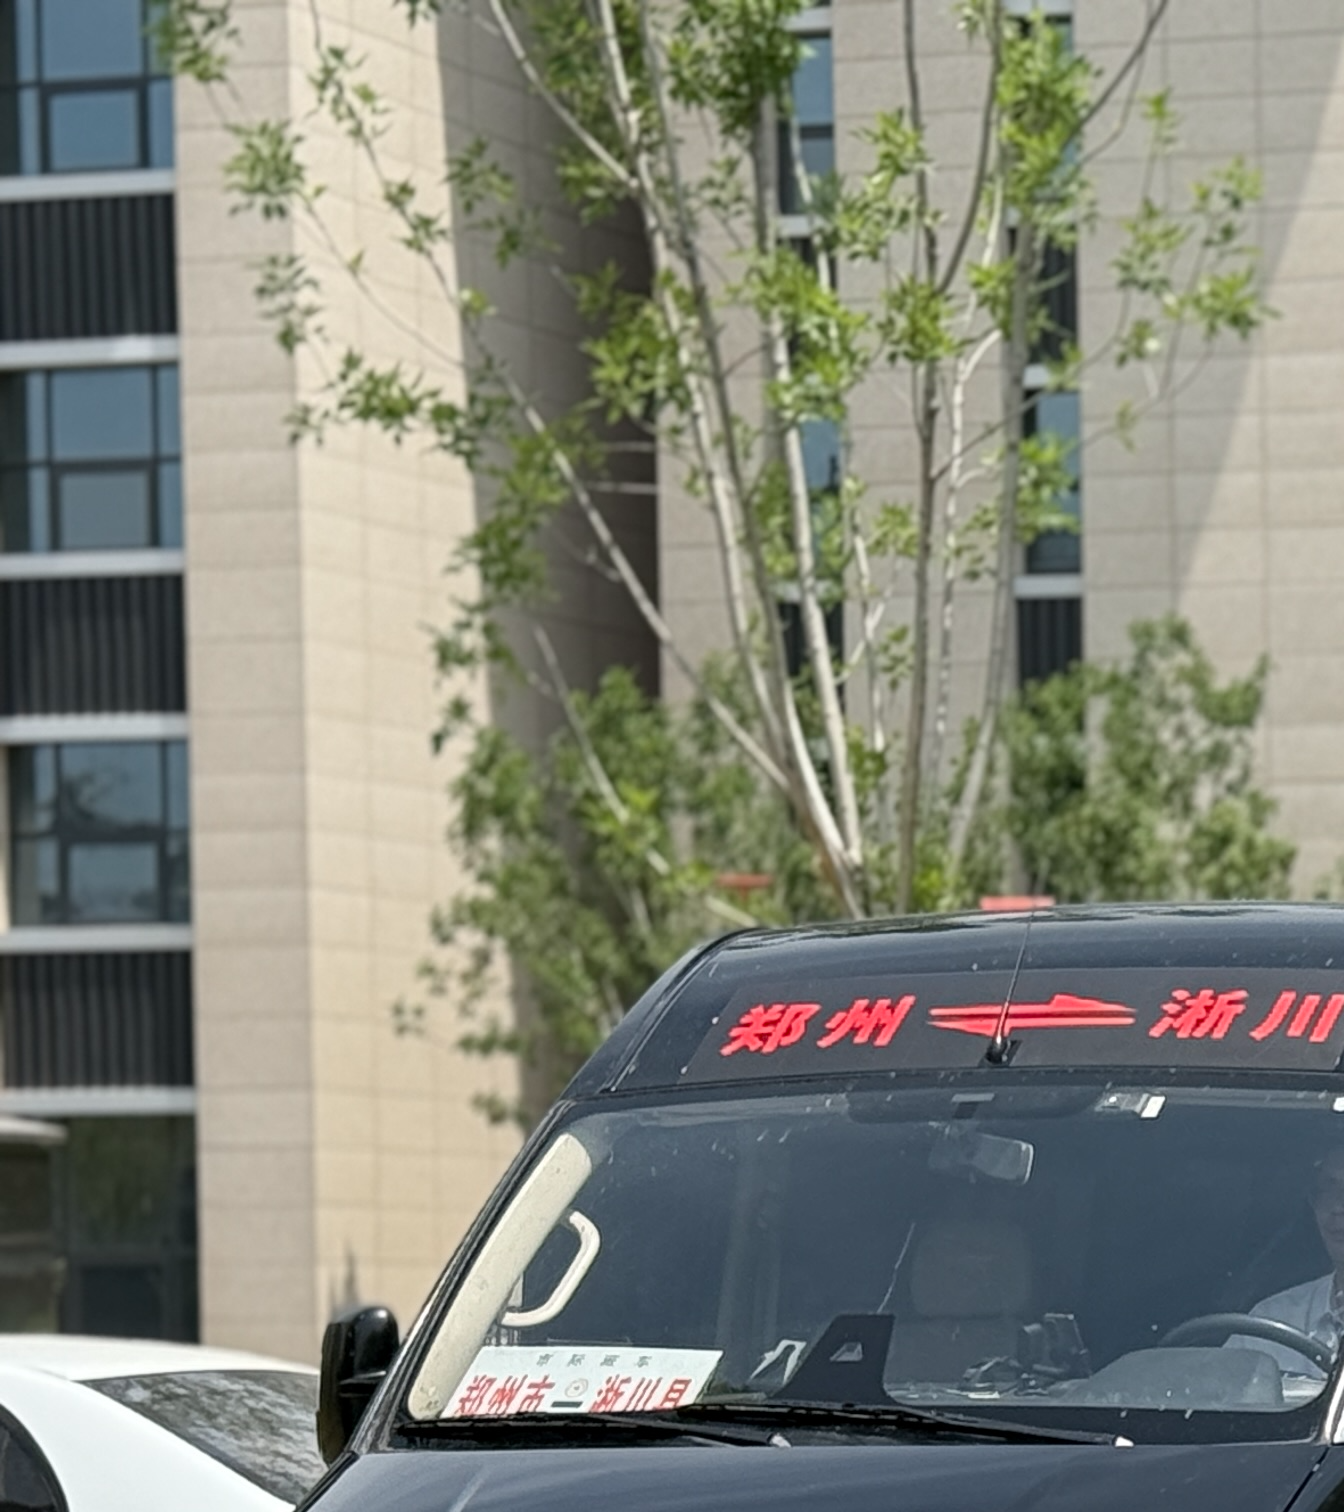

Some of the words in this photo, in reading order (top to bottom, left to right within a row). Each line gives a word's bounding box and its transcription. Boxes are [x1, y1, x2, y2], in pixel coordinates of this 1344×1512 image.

[720, 995, 916, 1057] 郑州
[454, 1374, 555, 1416] 郑州市
